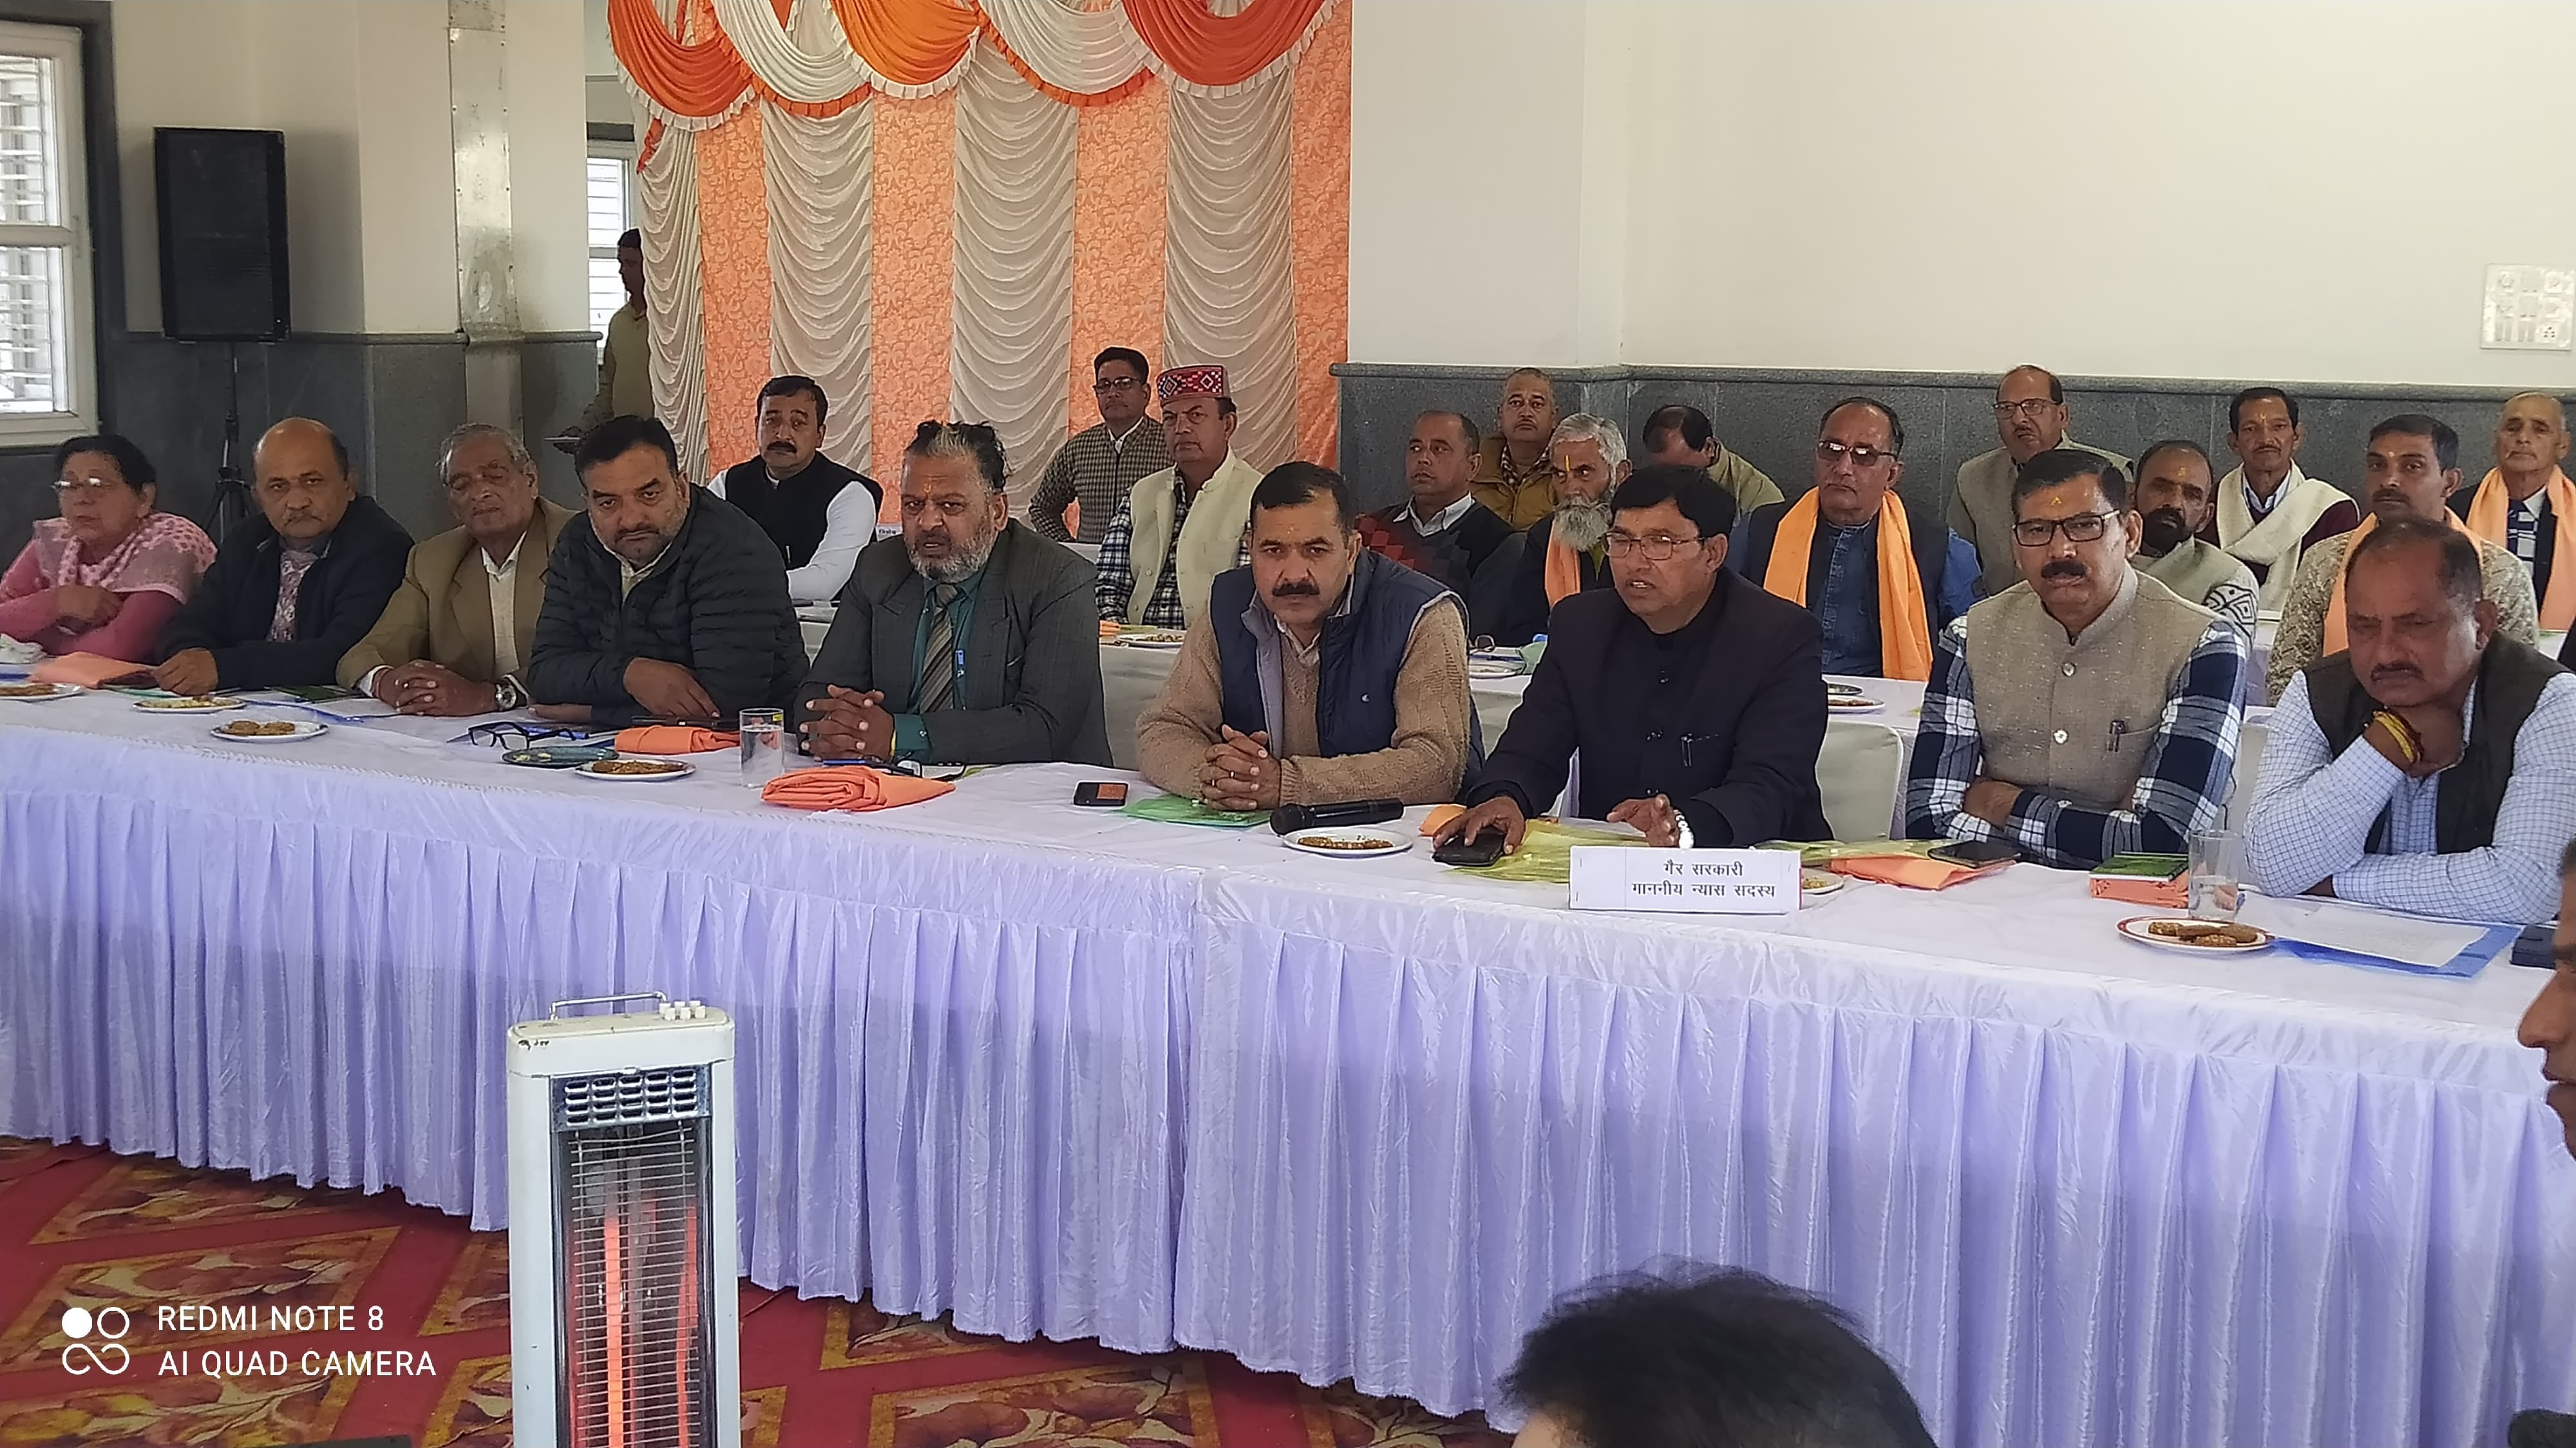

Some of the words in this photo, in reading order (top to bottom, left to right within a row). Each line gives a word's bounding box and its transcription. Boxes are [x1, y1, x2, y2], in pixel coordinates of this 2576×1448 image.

[1663, 859, 1683, 875] गैर
[1691, 861, 1743, 877] सरकारी
[1691, 884, 1726, 897] न्यास
[1733, 884, 1776, 897] सदस्य
